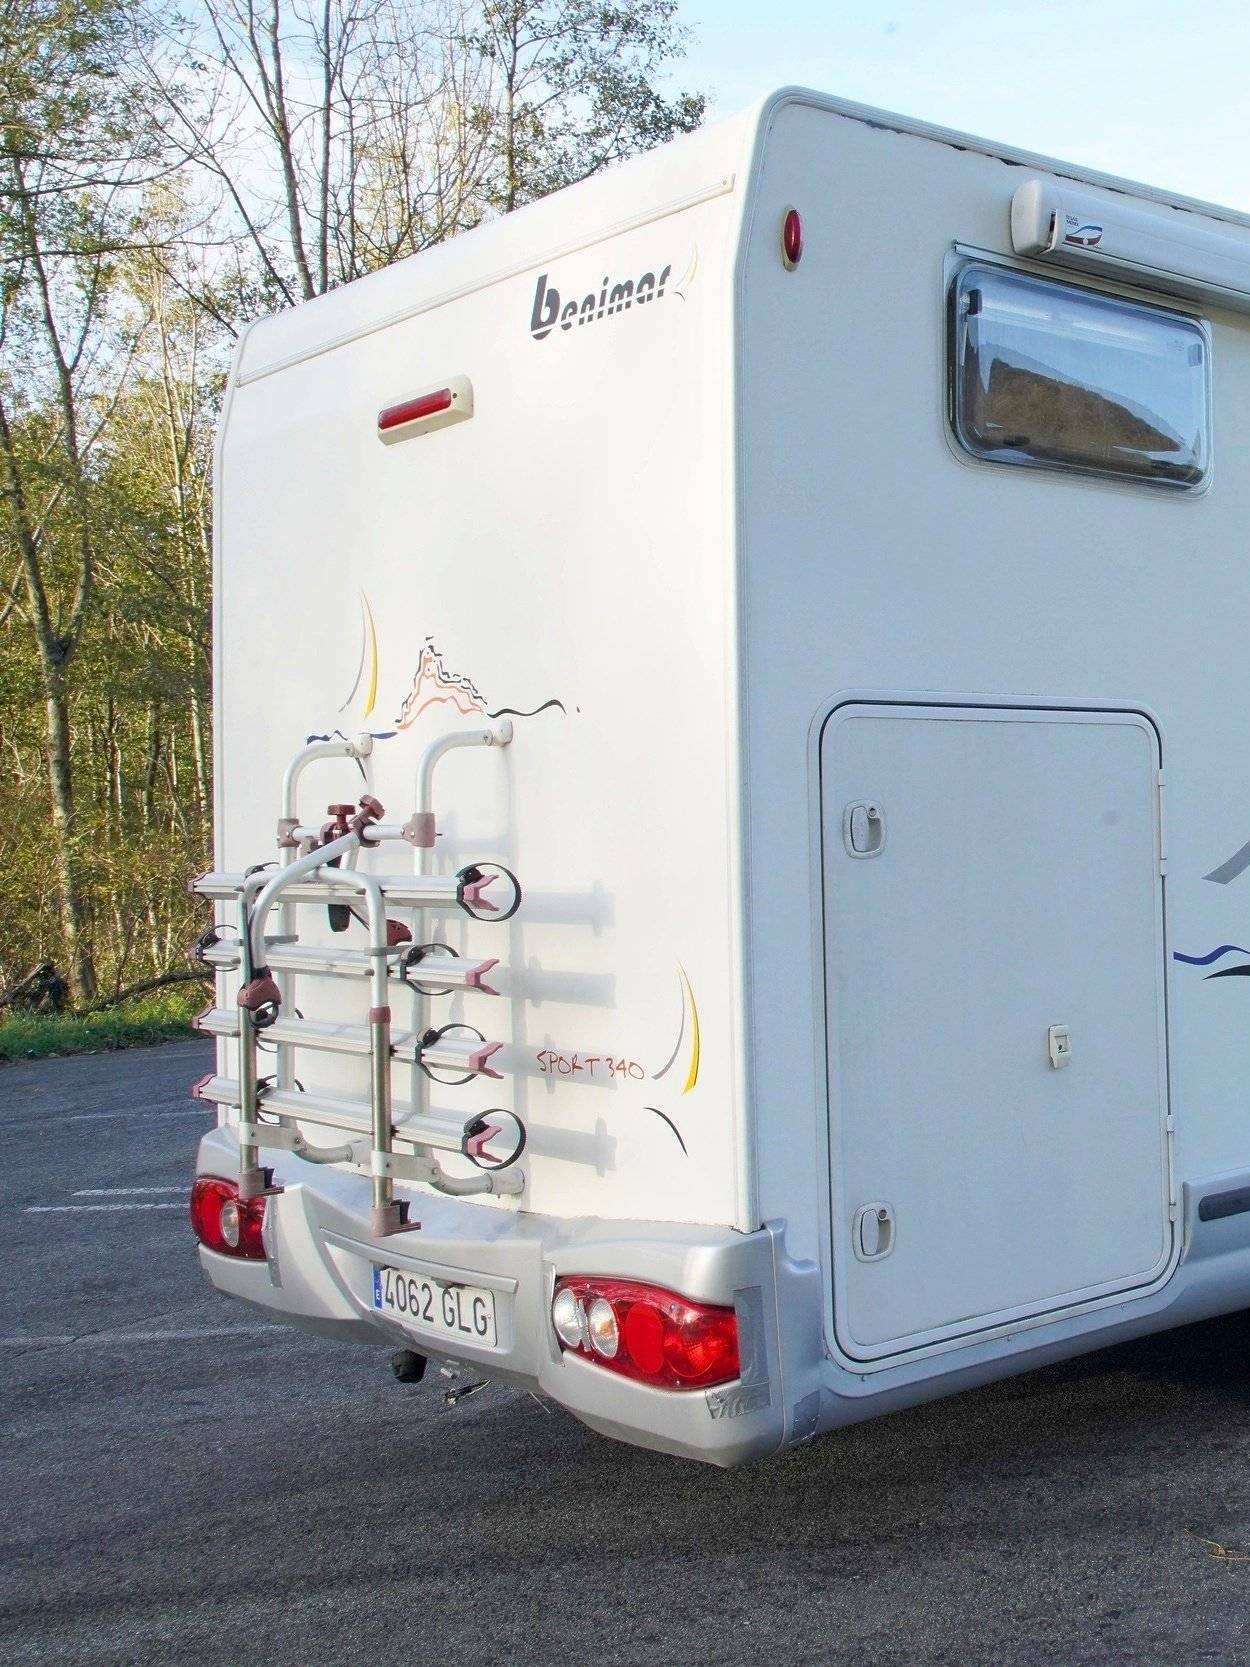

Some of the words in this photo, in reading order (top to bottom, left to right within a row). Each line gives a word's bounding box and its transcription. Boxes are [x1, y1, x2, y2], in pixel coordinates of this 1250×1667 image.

[530, 264, 672, 340] benimar
[536, 1050, 601, 1077] SPORT
[605, 1057, 645, 1080] 340
[384, 1271, 434, 1323] 4062
[441, 1287, 488, 1336] GLG
